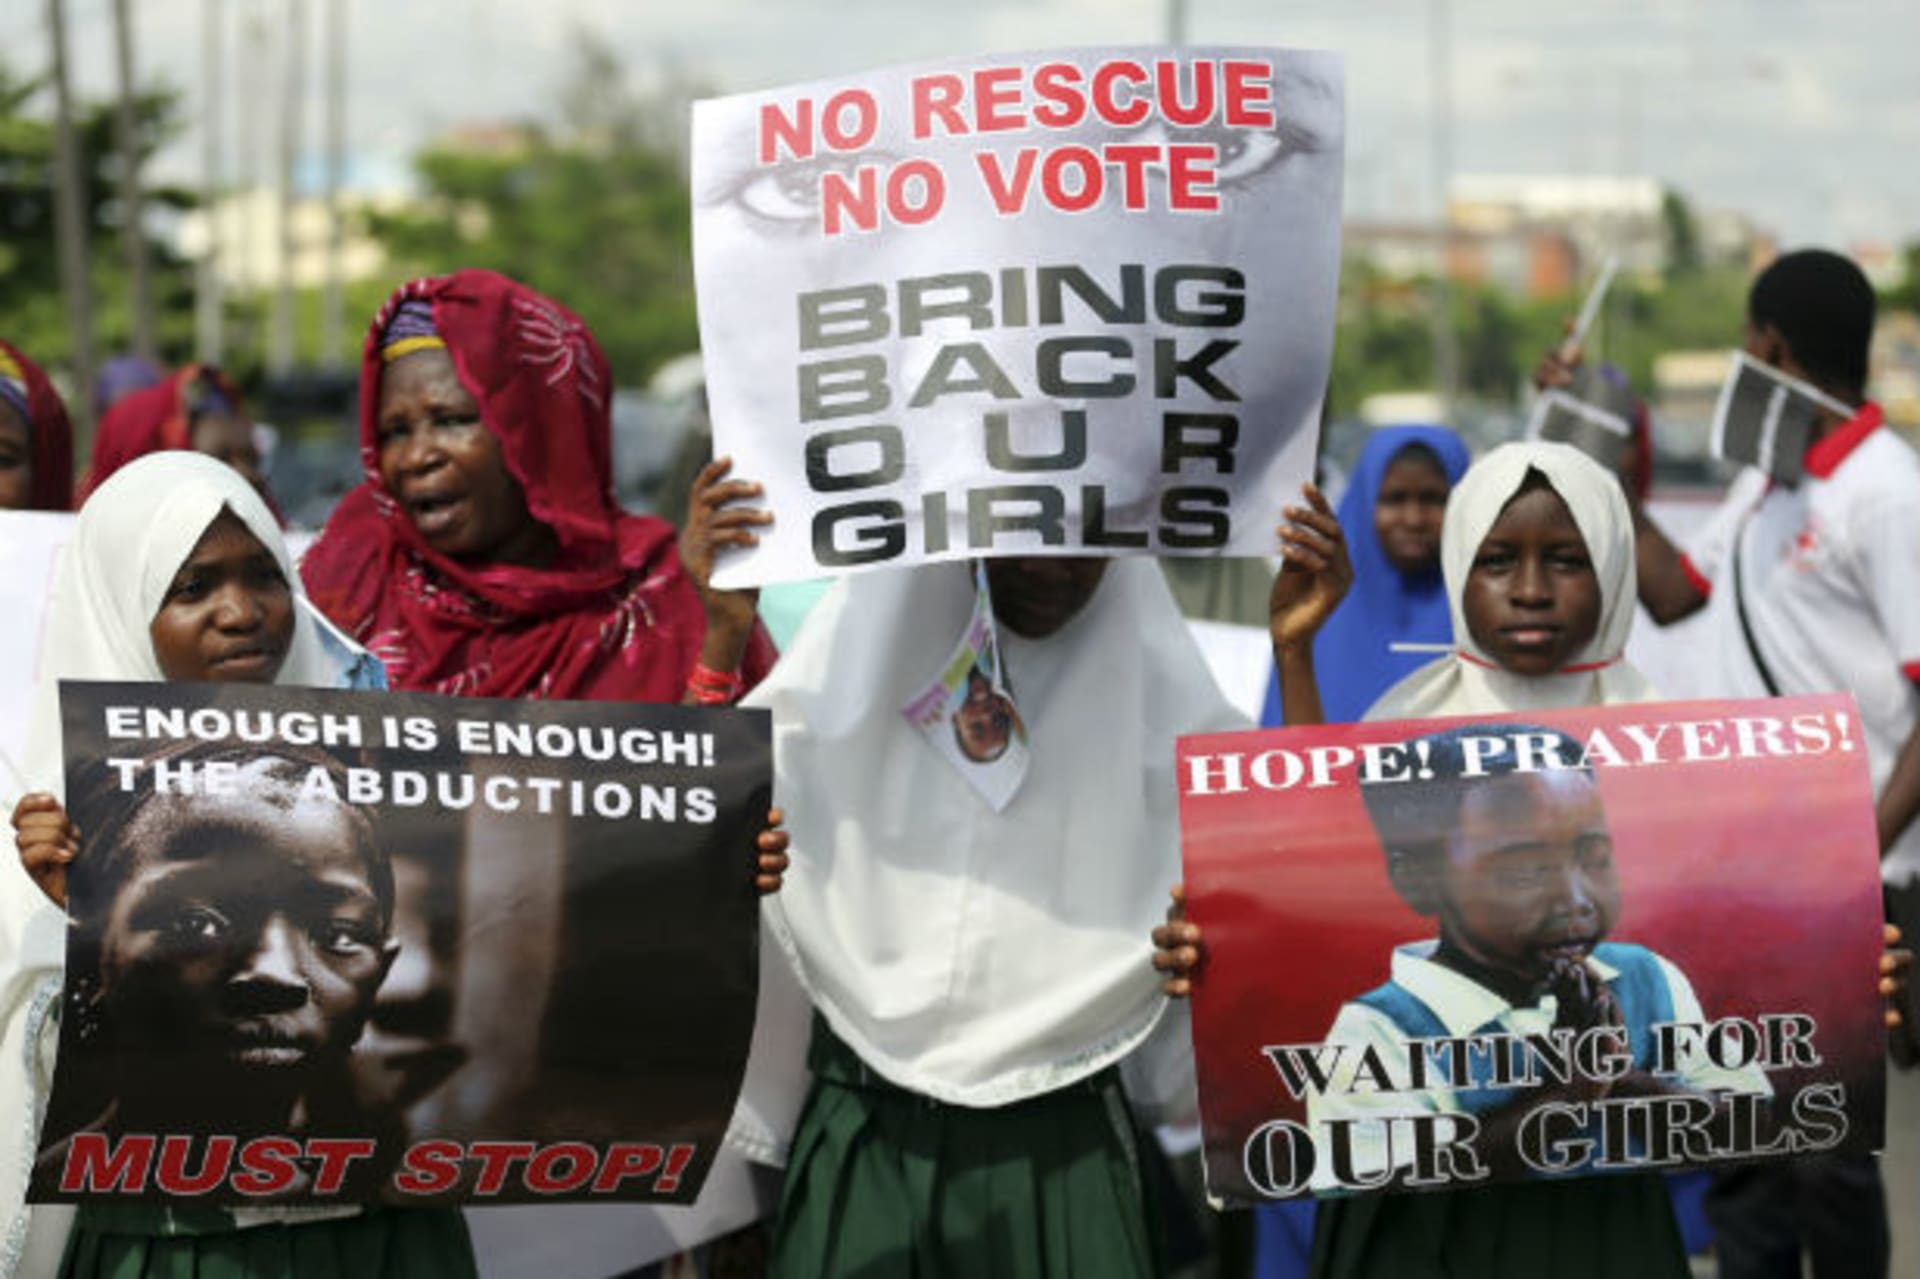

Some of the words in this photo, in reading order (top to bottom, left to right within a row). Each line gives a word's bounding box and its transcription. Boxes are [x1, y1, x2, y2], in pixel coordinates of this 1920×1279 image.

[758, 88, 879, 164] NO
[910, 60, 1274, 138] RESCUE
[821, 160, 945, 235] NO
[975, 144, 1221, 214] VOTE
[797, 264, 1246, 352] BRING
[797, 336, 1242, 423] BACK
[805, 410, 1241, 492] OUR
[811, 484, 1231, 567] GIRLS
[105, 707, 361, 748] ENOUGH
[384, 715, 438, 751] IS
[458, 721, 714, 766] ENOUGH!
[1186, 740, 1434, 795] HOPE!
[1458, 714, 1854, 780] PRAYERS!
[107, 758, 240, 796] THE
[302, 763, 717, 824] ABDUCTIONS
[1263, 1024, 1632, 1100] WAITING
[1652, 1013, 1821, 1074] FOR
[61, 1135, 375, 1194] MUST
[395, 1141, 696, 1196] STOP!
[1244, 1111, 1490, 1198] OUR
[1517, 1084, 1848, 1172] GIRLS
